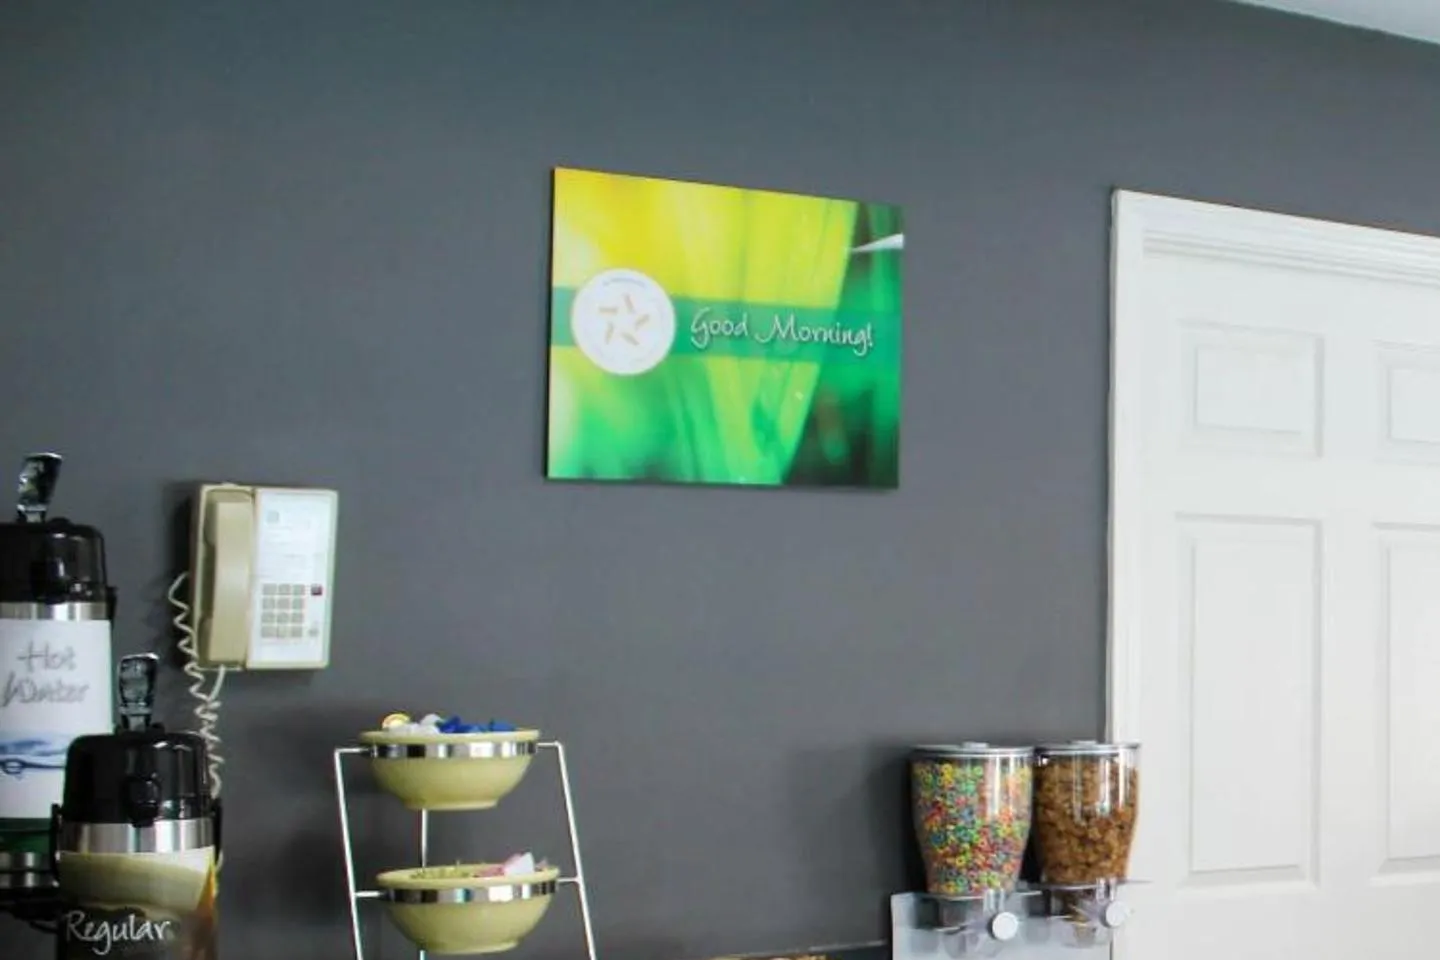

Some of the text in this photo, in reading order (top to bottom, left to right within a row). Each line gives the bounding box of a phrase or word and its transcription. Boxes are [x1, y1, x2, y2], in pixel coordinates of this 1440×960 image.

[690, 306, 874, 357] Good Morning!
[16, 640, 78, 673] Hot
[65, 909, 172, 955] Regular
